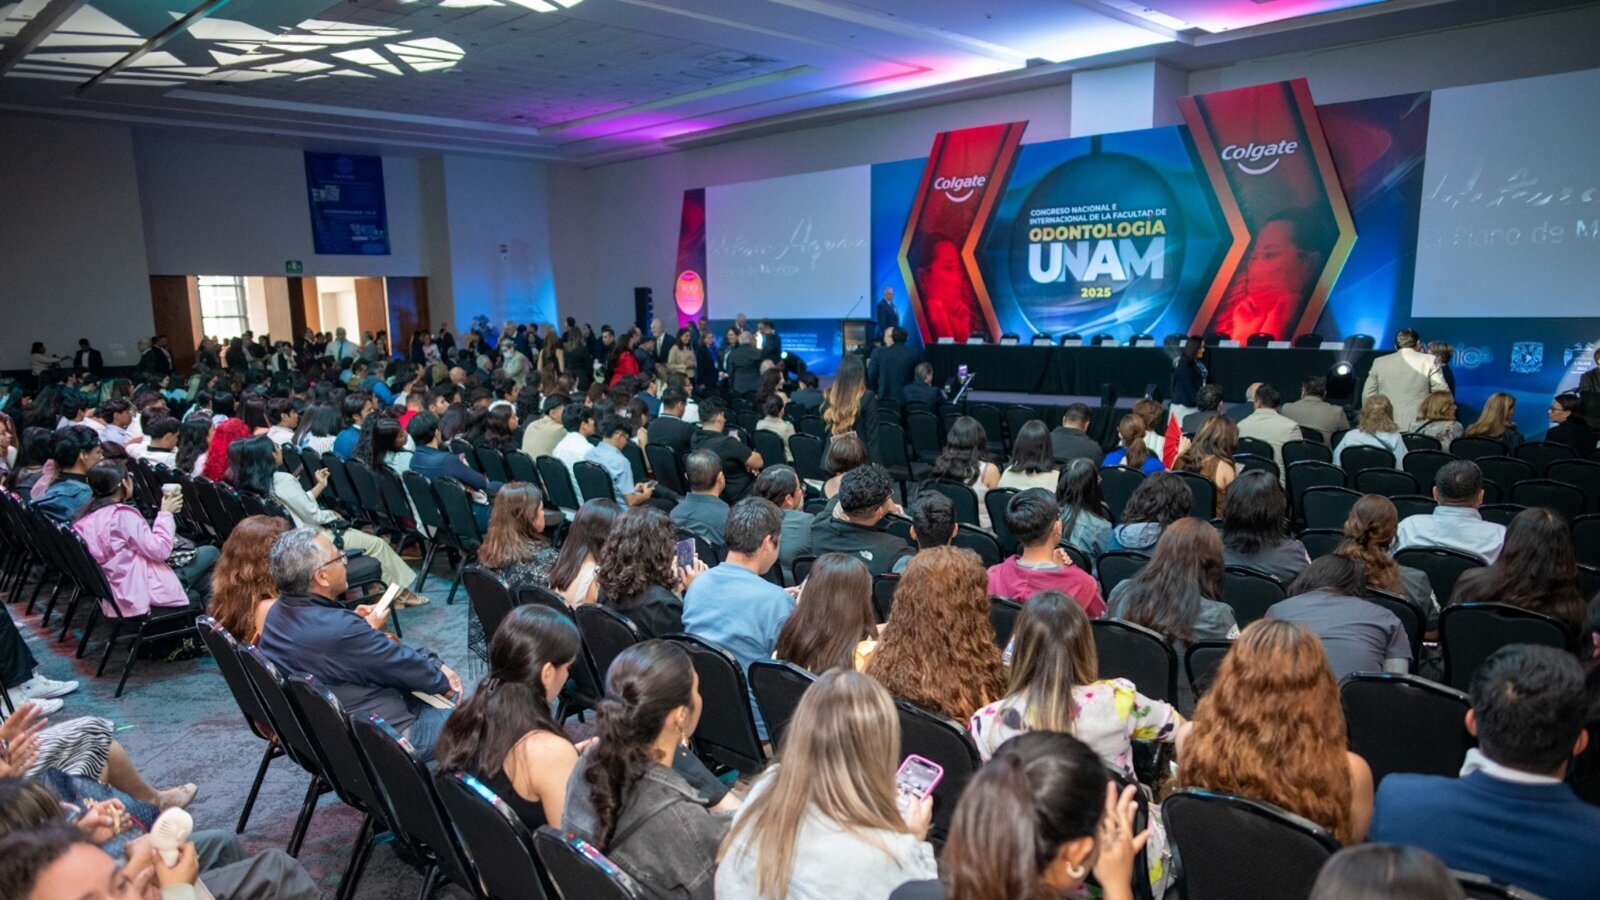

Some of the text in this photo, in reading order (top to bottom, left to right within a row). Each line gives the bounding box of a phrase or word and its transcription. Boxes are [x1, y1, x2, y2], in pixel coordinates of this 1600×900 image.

[1221, 140, 1298, 162] Colgate
[934, 174, 986, 192] Colgate
[1029, 208, 1167, 225] INTERNACIONAL DE LA FACULTAD DE
[1030, 203, 1118, 217] CONGRESO NACIONAL E
[1028, 236, 1166, 284] UNAM
[1080, 287, 1112, 298] 2025
